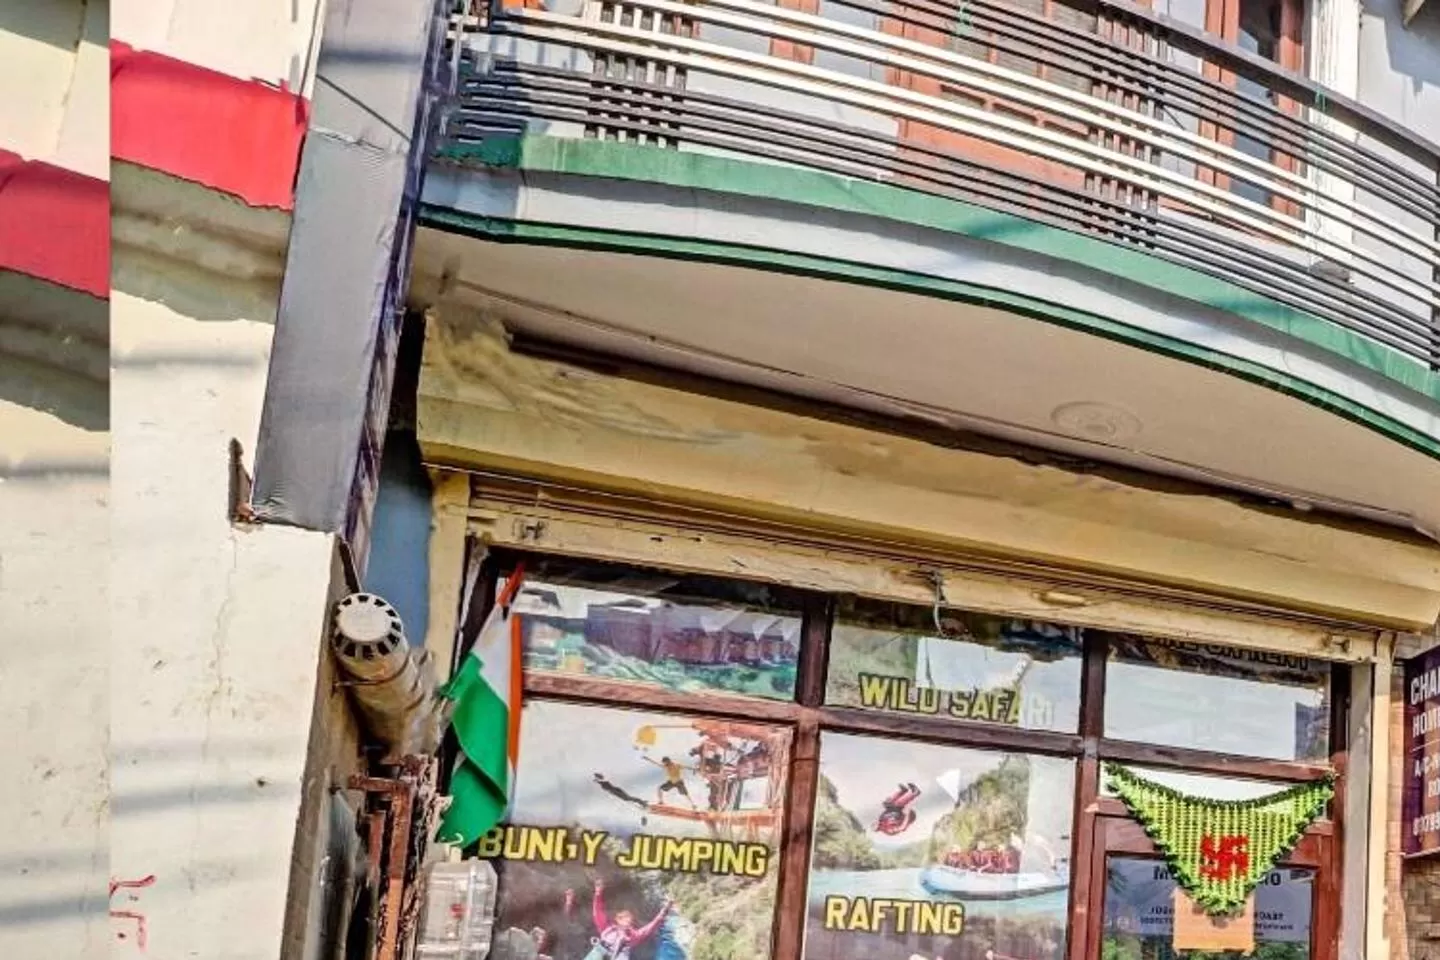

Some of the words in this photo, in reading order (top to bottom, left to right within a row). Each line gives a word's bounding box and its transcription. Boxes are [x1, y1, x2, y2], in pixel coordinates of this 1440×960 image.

[858, 671, 940, 714] WILD
[617, 833, 769, 878] JUMPING
[825, 894, 965, 936] RAFTING
